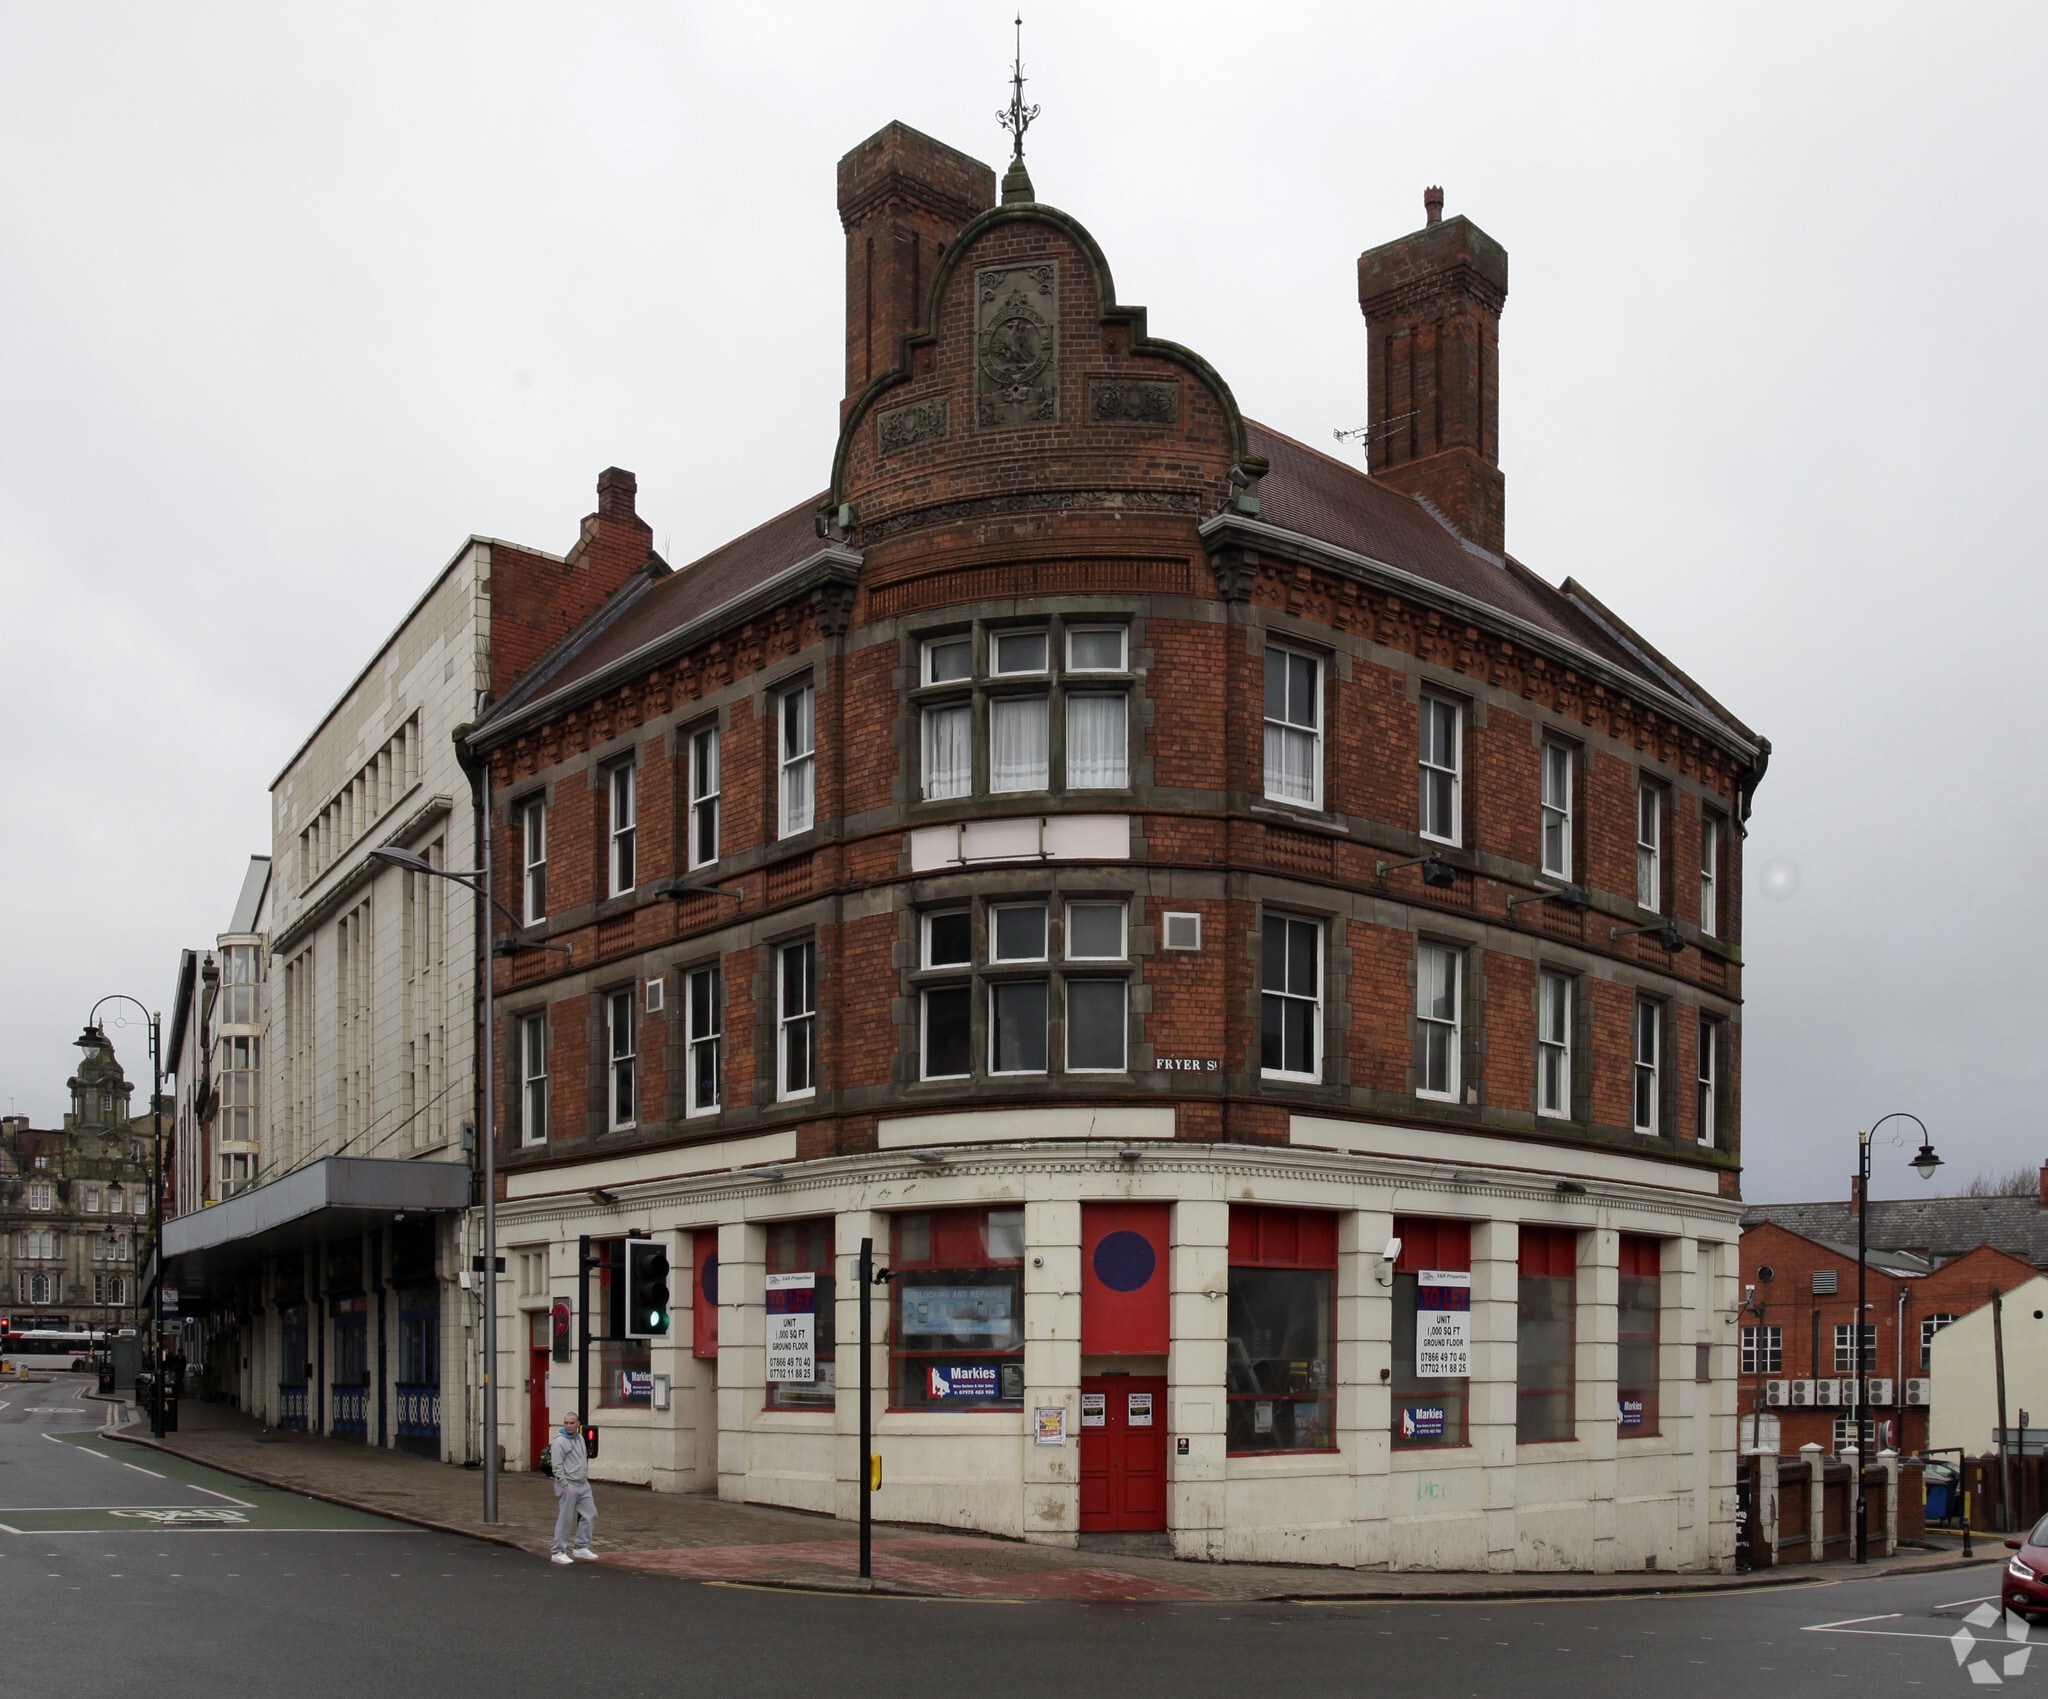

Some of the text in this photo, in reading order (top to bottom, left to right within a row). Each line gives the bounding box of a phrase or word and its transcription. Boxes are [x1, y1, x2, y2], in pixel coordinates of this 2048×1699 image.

[1156, 1058, 1200, 1070] FRYER
[768, 1289, 812, 1312] TO LET
[1422, 1287, 1467, 1309] TO LET
[783, 1318, 796, 1327] UNIT
[1436, 1315, 1450, 1324] UNIT
[776, 1330, 805, 1339] 1,000 SQ FT
[1427, 1327, 1460, 1337] 1,000 SQ FT
[773, 1342, 808, 1351] GROUND FLOOR
[1424, 1339, 1445, 1347] GROUND
[1421, 1353, 1466, 1361] 07866 49 70 40
[770, 1358, 810, 1366] 07866 49 70 40
[1421, 1364, 1466, 1372] 07702 11 88 25
[770, 1369, 786, 1378] 07702
[787, 1369, 794, 1378] 11
[795, 1369, 802, 1378] 88
[804, 1369, 811, 1378] 25
[951, 1367, 996, 1379] Markies
[1416, 1408, 1443, 1419] Markies
